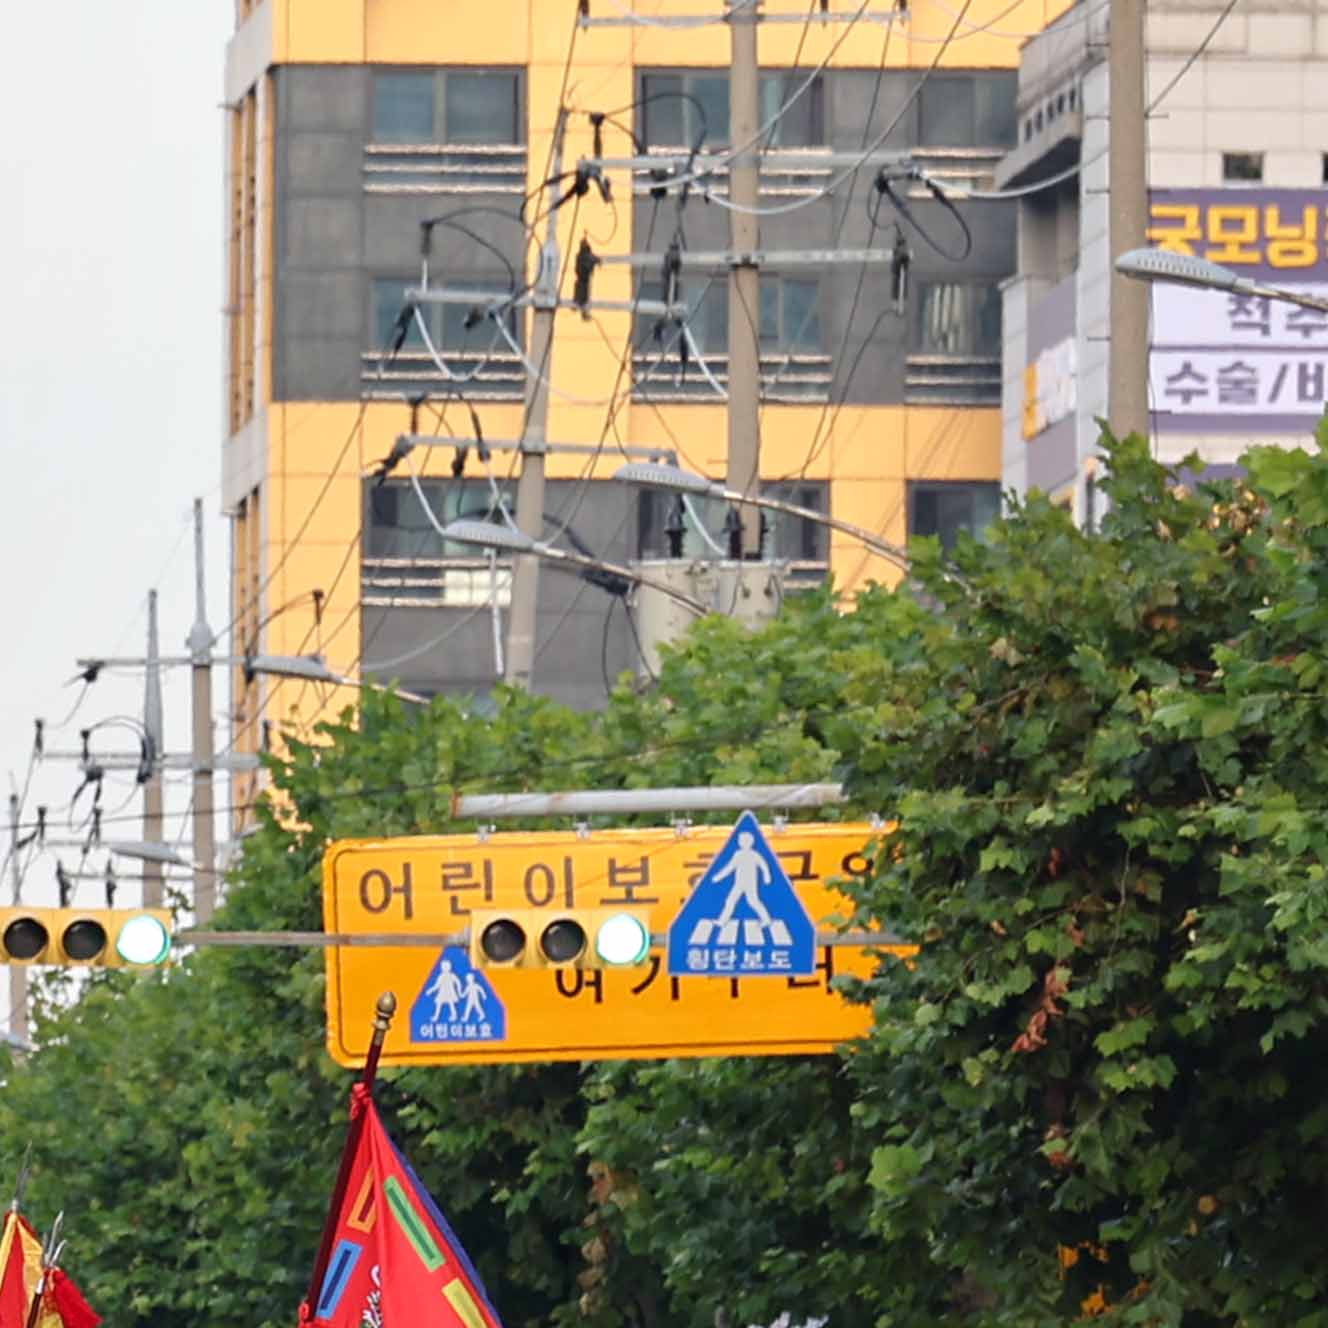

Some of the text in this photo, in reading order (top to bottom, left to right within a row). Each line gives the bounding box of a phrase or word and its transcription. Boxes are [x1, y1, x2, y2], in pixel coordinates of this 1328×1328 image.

[1145, 204, 1328, 268] 굿모닝
[687, 948, 792, 971] 횡단보도
[419, 1023, 493, 1039] 어린이보호
